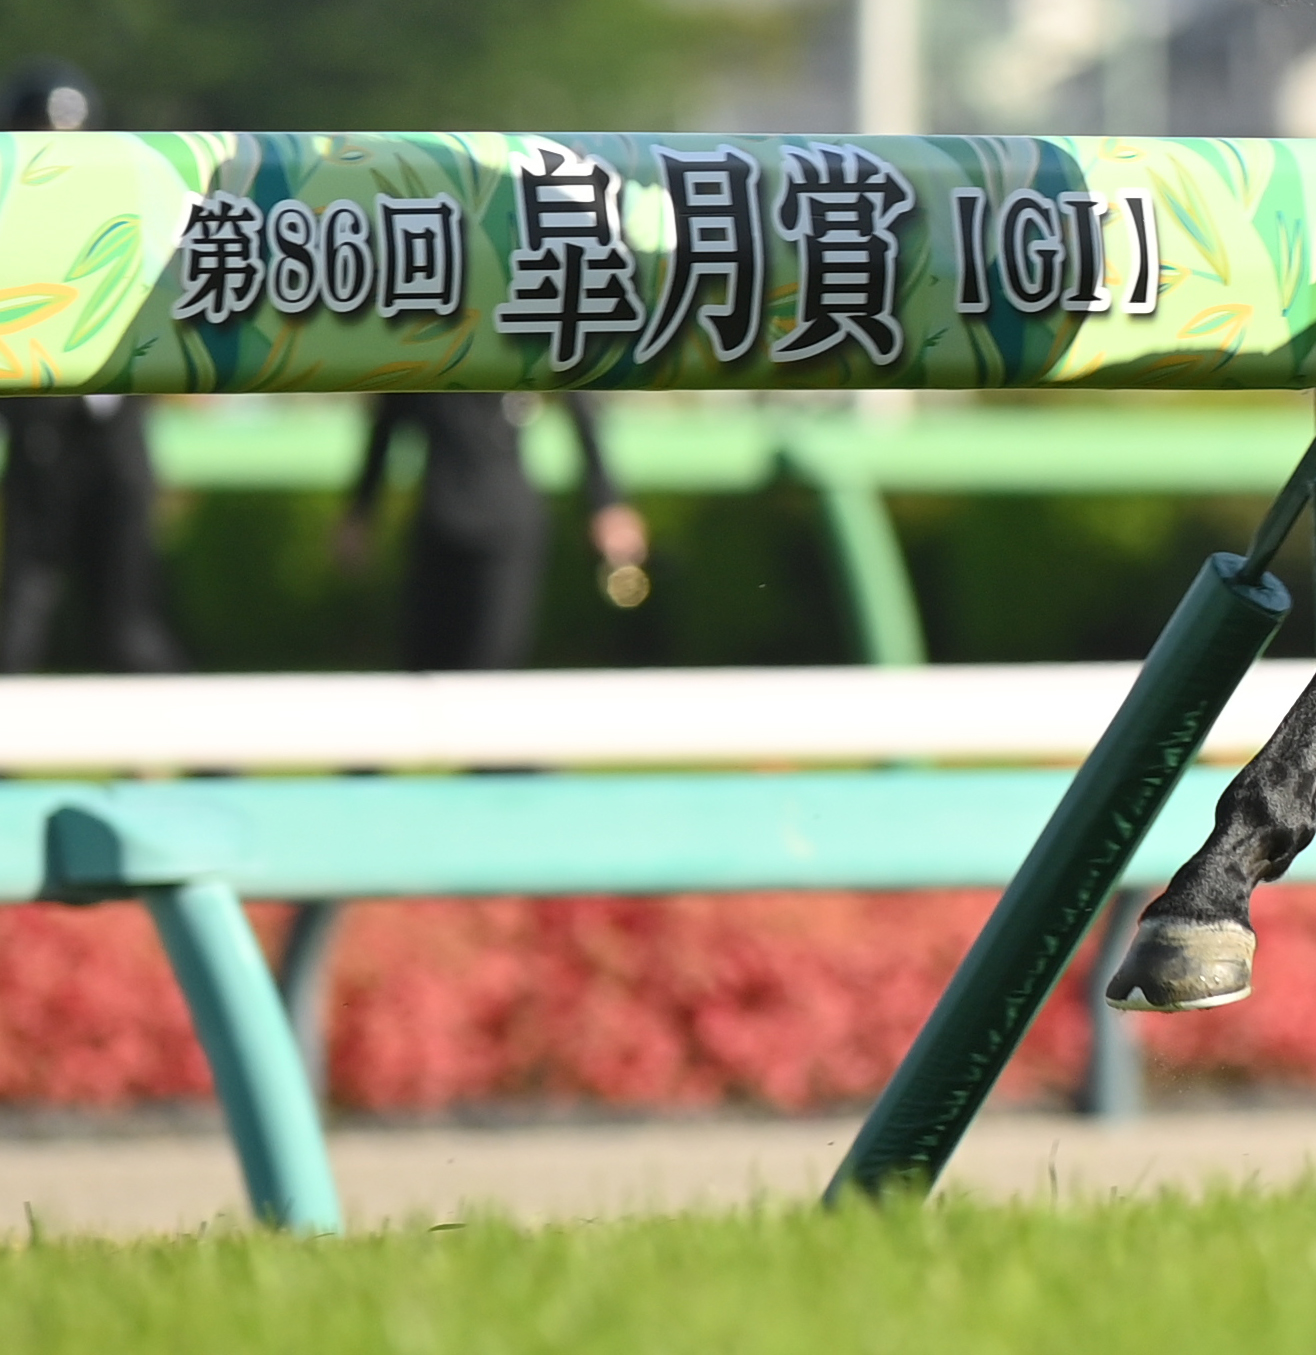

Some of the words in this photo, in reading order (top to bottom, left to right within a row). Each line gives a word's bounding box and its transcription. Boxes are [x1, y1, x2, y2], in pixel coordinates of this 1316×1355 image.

[172, 192, 463, 323] 第86回
[495, 145, 915, 371] 皐月賞
